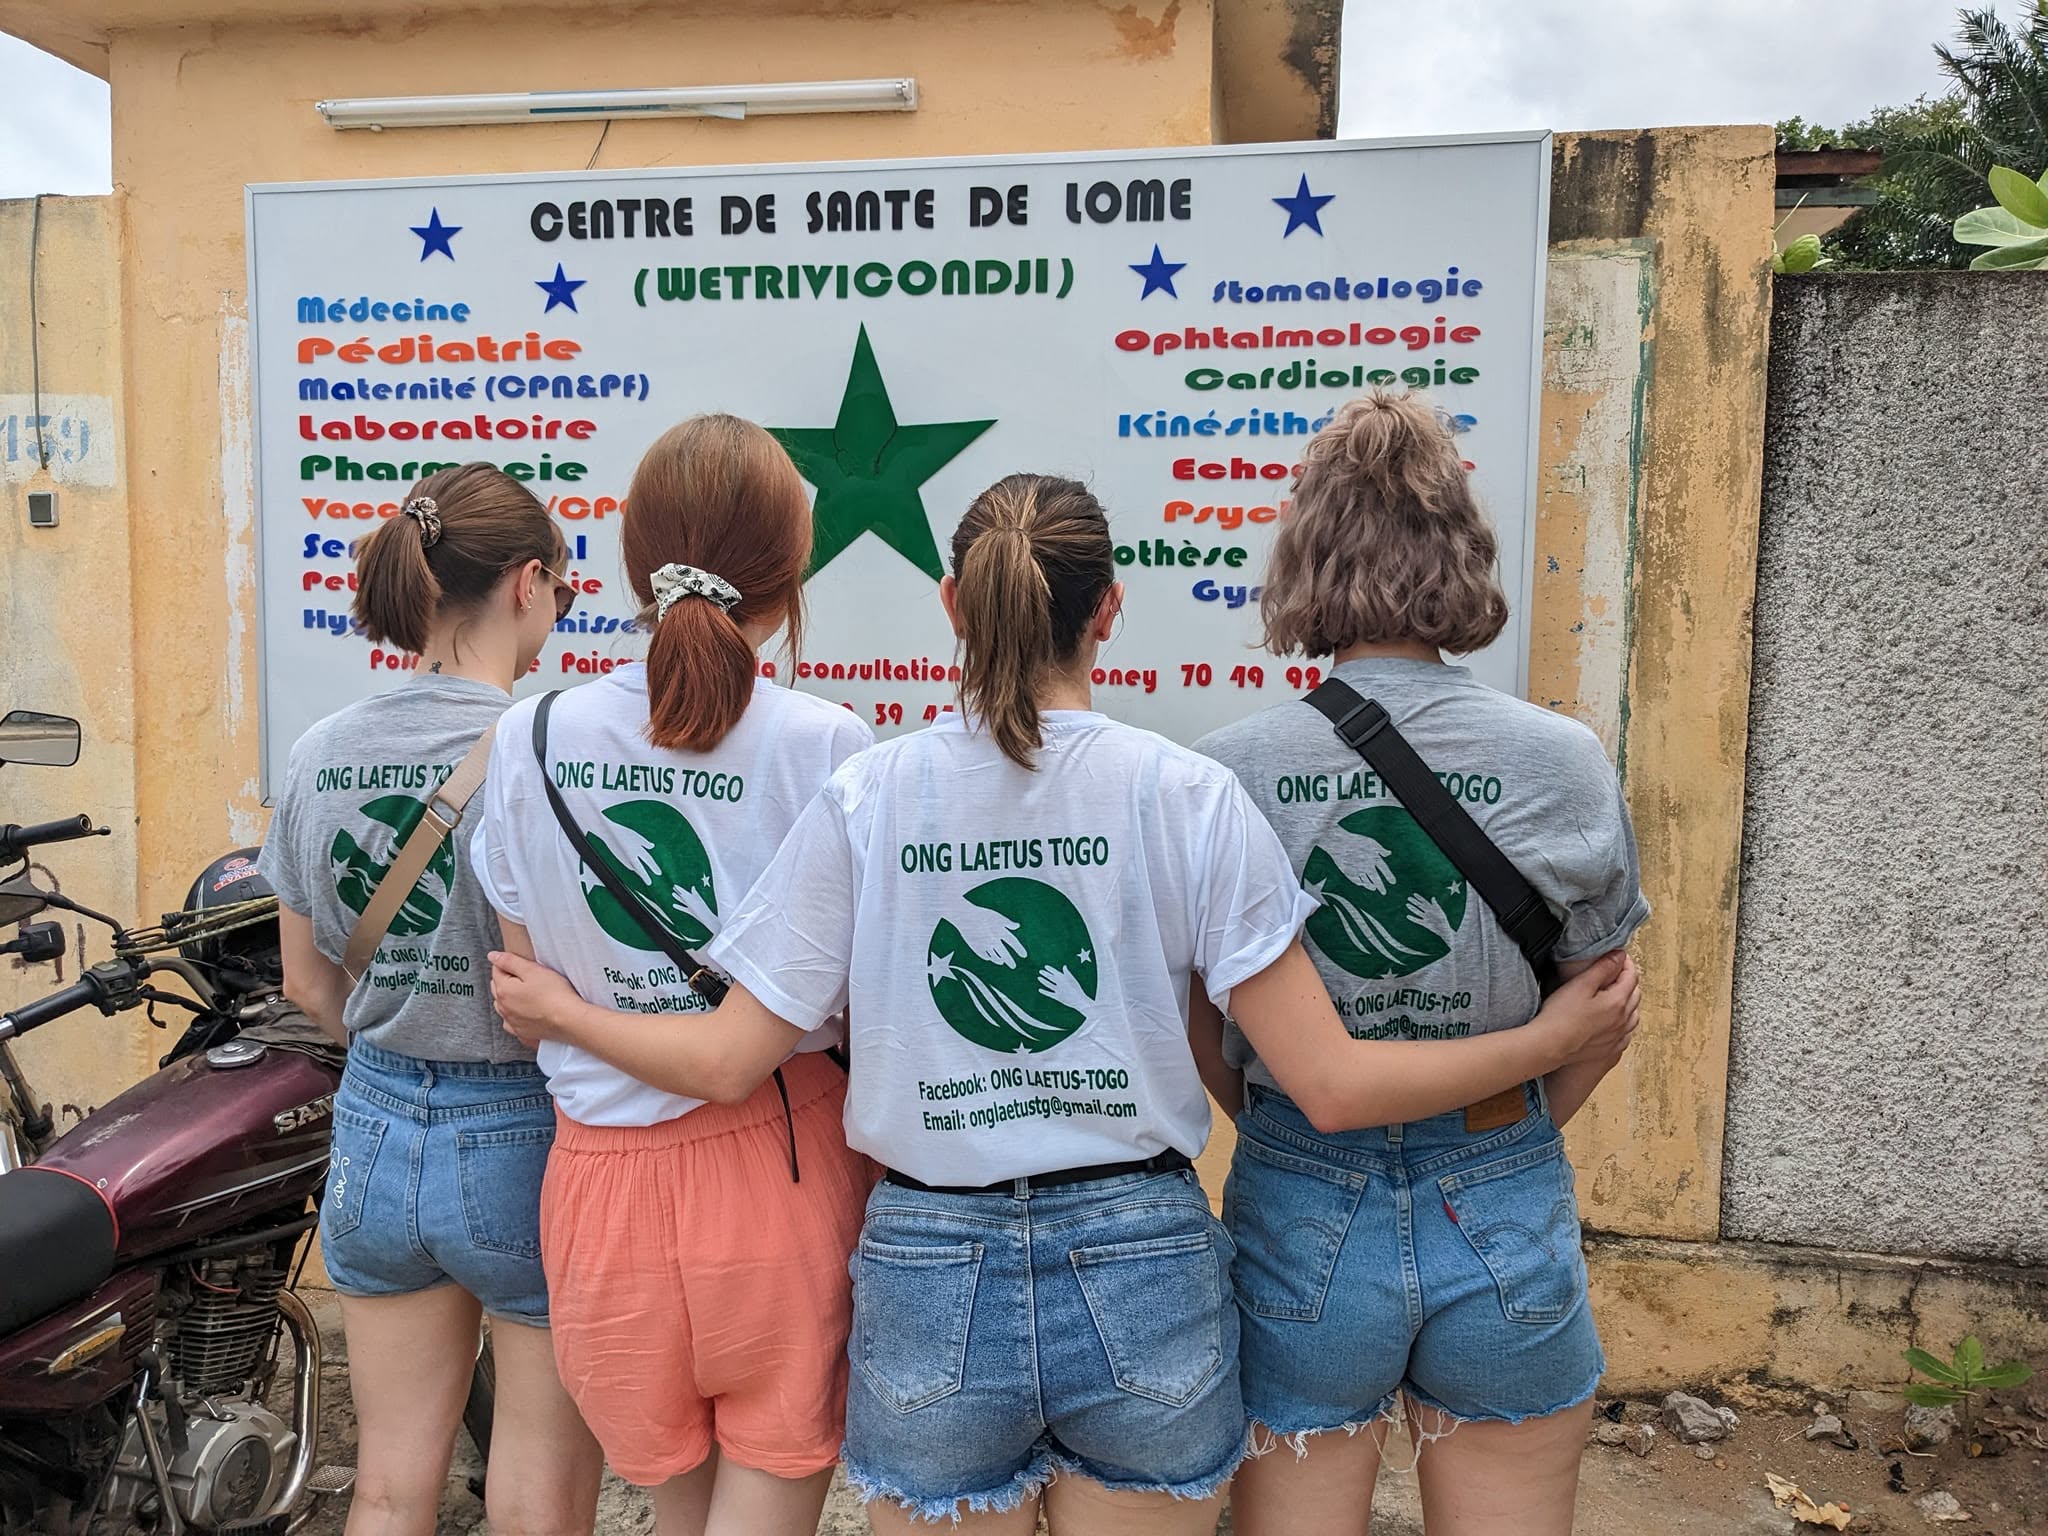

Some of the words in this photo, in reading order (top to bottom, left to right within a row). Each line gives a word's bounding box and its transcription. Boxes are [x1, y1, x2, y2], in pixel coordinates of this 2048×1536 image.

[531, 197, 694, 242] CENTRE
[721, 194, 777, 235] DE
[806, 188, 935, 235] SANTE
[969, 184, 1029, 228] DE
[1065, 178, 1192, 225] LOME
[1212, 266, 1483, 303] Stomatologie
[297, 296, 471, 323] Médecine
[297, 332, 583, 365] Pédiatrie
[1114, 315, 1482, 356] Ophtalmologie
[298, 376, 476, 401] Maternité
[1184, 358, 1481, 392] Cardiologie
[299, 414, 598, 442] Laboratoire
[299, 452, 589, 482] Pharcie
[797, 657, 962, 682] consultation
[1090, 667, 1158, 694] oney
[1180, 663, 1213, 687] 70
[1229, 665, 1265, 689] 49
[875, 702, 904, 726] 39
[316, 766, 353, 793] ONG
[358, 764, 427, 790] LAETUS
[556, 761, 594, 789] ONG
[602, 763, 676, 795] LAETUS
[681, 769, 744, 803] TOGO
[1277, 773, 1329, 804] ONG
[1337, 771, 1388, 801] LAET
[901, 843, 953, 873] ONG
[960, 839, 1043, 871] LAETUS
[1047, 836, 1109, 866] TOGO
[391, 947, 419, 964] ONG
[647, 966, 677, 989] ONG
[1355, 994, 1385, 1017] ONG
[918, 1072, 988, 1101] Facebook:
[990, 1067, 1023, 1090] ONG
[1026, 1068, 1129, 1090] LAETUS-TOGO
[922, 1110, 966, 1131] Email:
[969, 1096, 1138, 1129] onglaetustg@gmail.com
